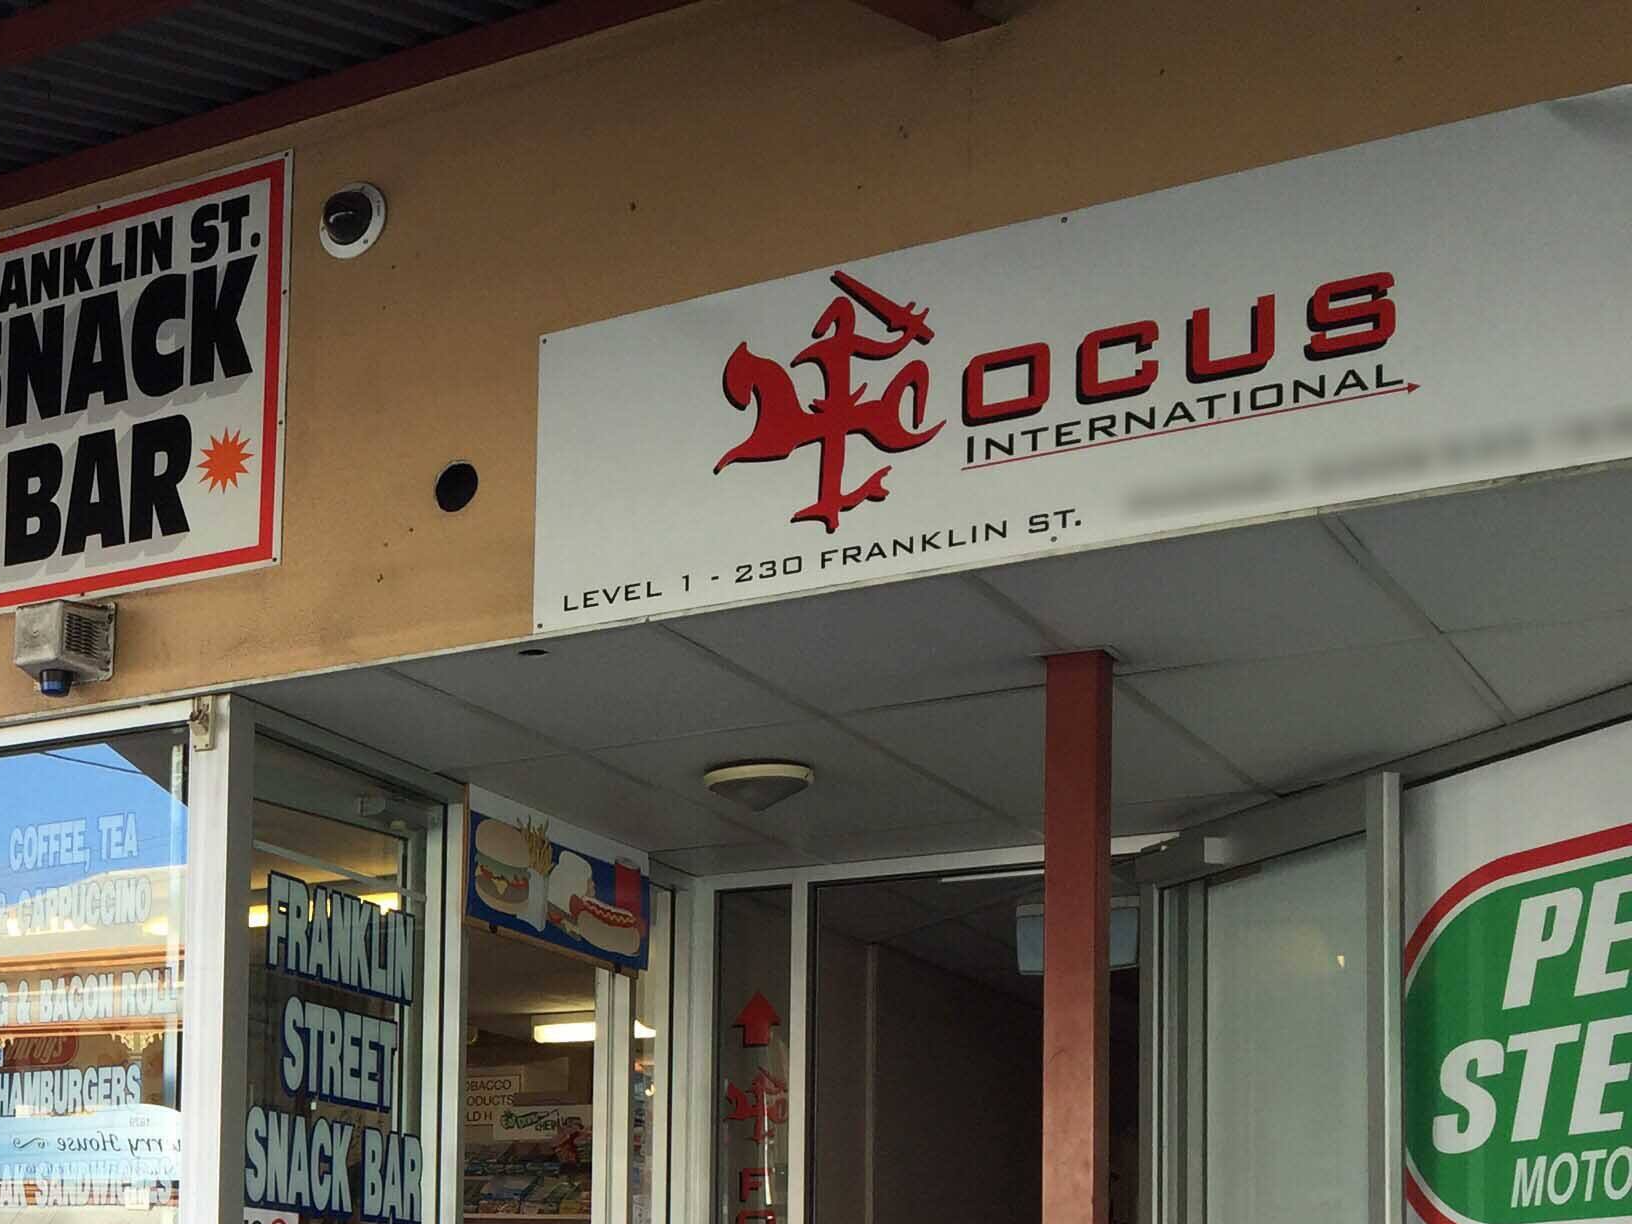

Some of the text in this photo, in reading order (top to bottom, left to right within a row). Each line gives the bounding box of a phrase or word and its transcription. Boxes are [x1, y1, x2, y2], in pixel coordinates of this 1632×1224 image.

[190, 195, 262, 264] ST.
[966, 363, 1405, 464] INTERNATIONAL
[3, 414, 192, 567] BAR
[563, 580, 662, 612] LEVEL
[681, 574, 691, 593] 1
[735, 555, 802, 584] 230
[820, 520, 1008, 569] FRANKLIN
[1028, 508, 1082, 535] ST.
[97, 813, 139, 861] TEA
[19, 876, 153, 933] CAPPUCCINO
[269, 870, 416, 1005] FRANKLIN
[1502, 873, 1632, 1010] PE
[39, 974, 114, 1022] BACON
[282, 995, 398, 1112] STREET
[466, 1095, 514, 1106] ODUCTS
[1432, 1014, 1632, 1154] STE
[244, 1105, 423, 1224] SNACK BAR
